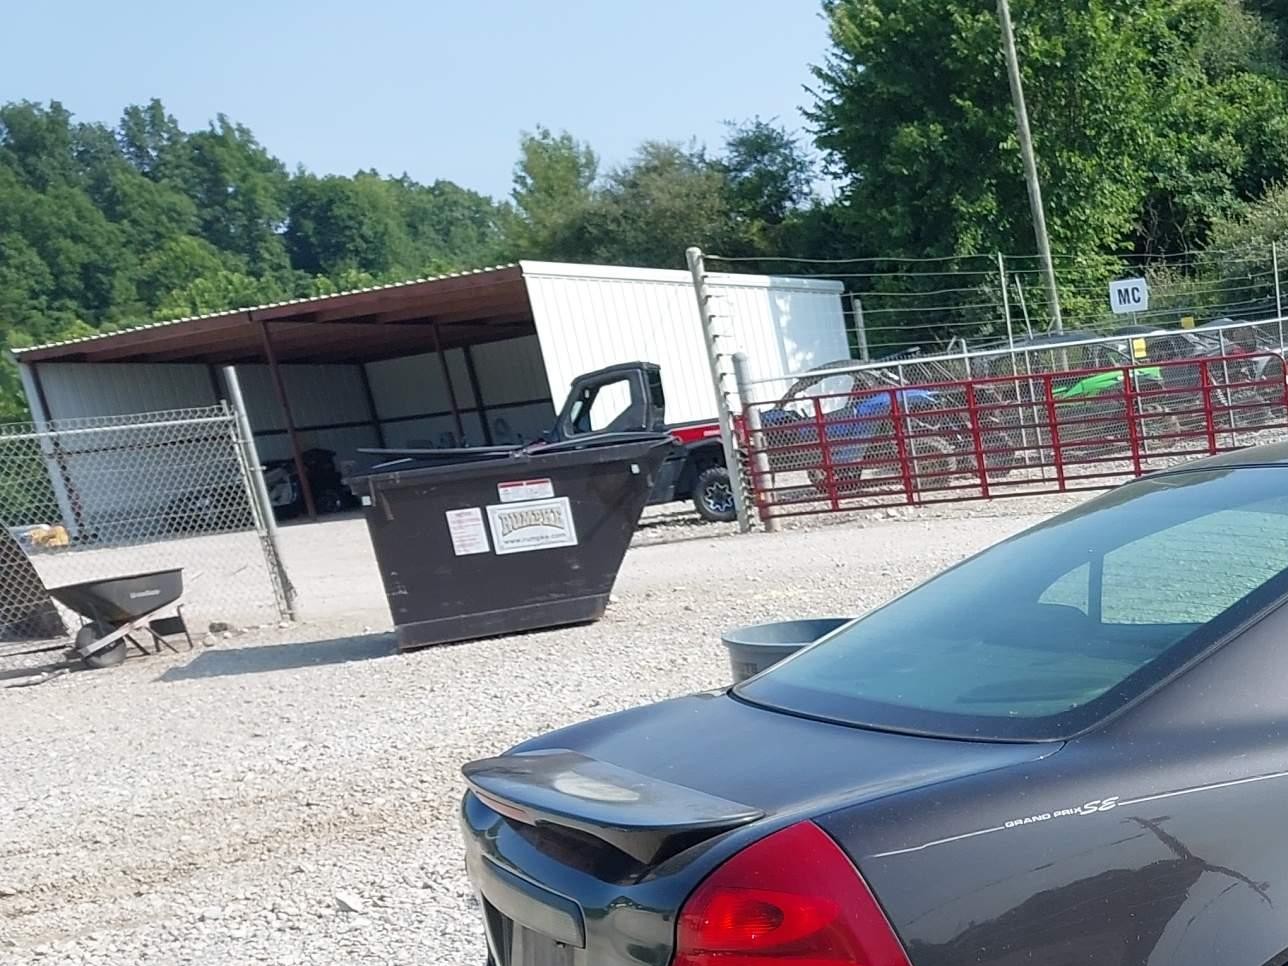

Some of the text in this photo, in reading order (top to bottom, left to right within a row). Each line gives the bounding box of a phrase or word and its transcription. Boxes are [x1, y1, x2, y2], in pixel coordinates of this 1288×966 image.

[1117, 287, 1142, 305] MC
[1005, 796, 1119, 828] GRAND PRIX SE
